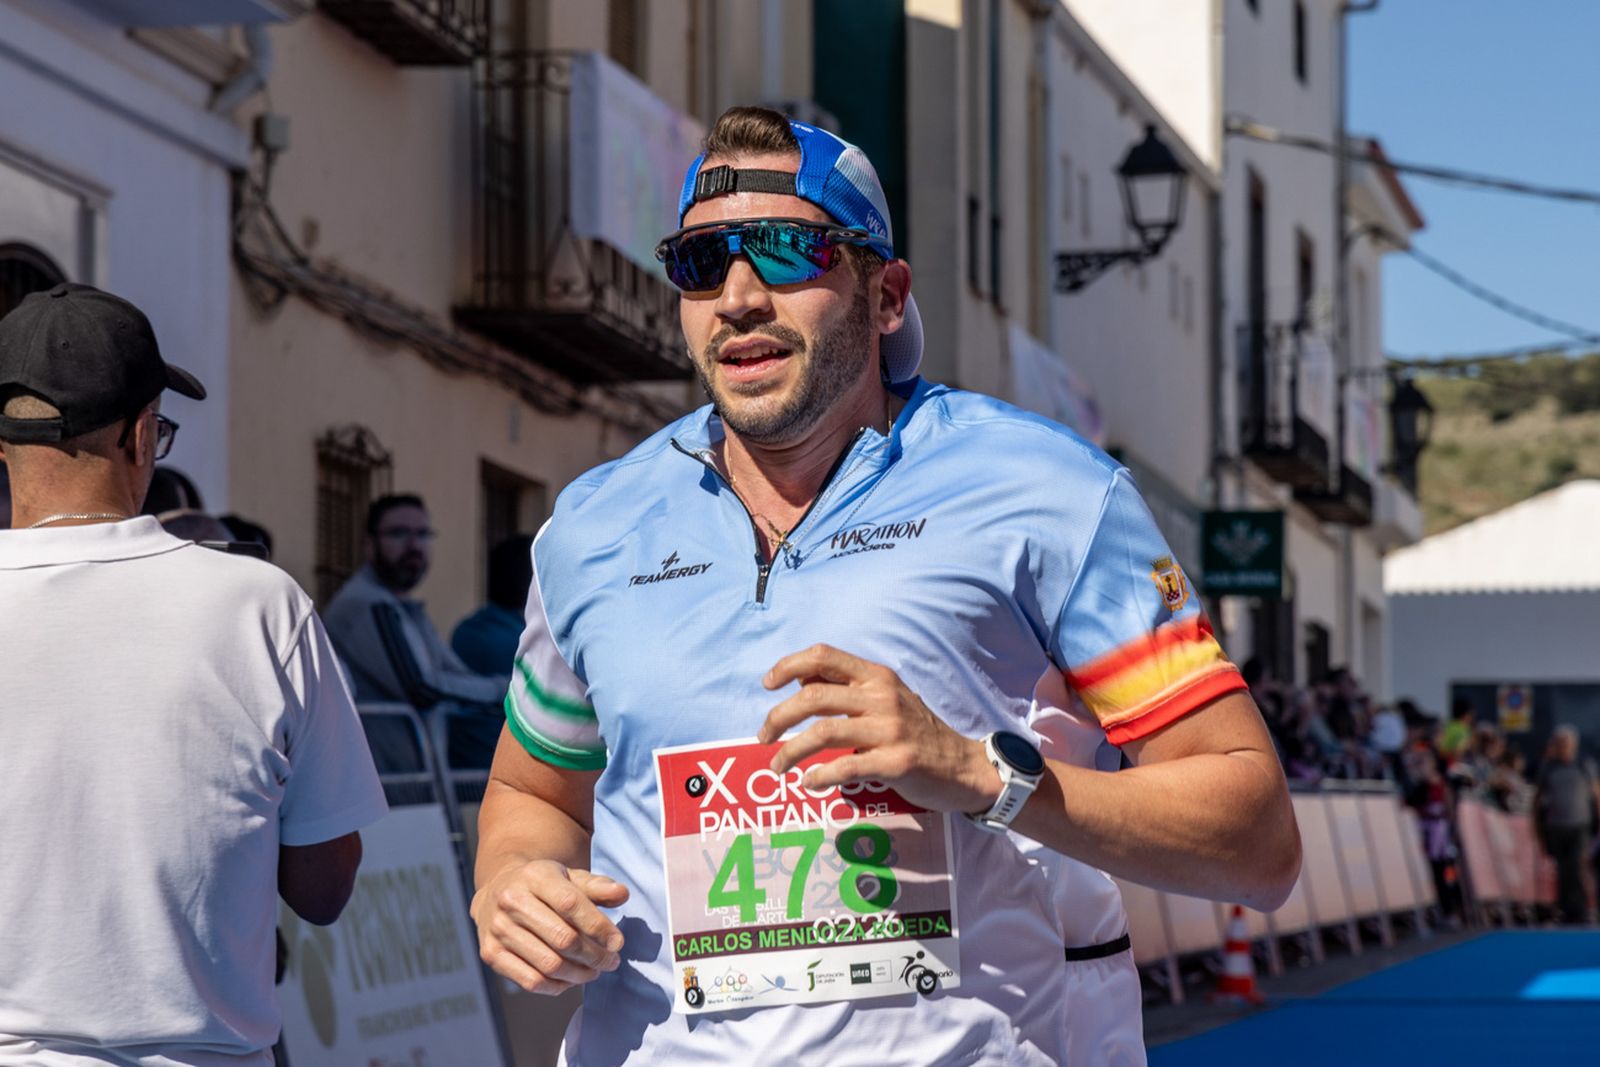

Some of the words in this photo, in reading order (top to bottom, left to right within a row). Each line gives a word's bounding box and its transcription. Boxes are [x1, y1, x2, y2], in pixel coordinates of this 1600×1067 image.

[831, 518, 927, 549] MARATHON
[627, 562, 713, 587] TEAMERGY
[697, 757, 738, 808] X
[699, 798, 860, 842] PANTANO
[866, 803, 895, 818] DEL
[708, 823, 898, 923] 478
[676, 932, 752, 957] CARLOS
[758, 922, 865, 949] MENDOZA
[872, 916, 951, 939] RUEDA
